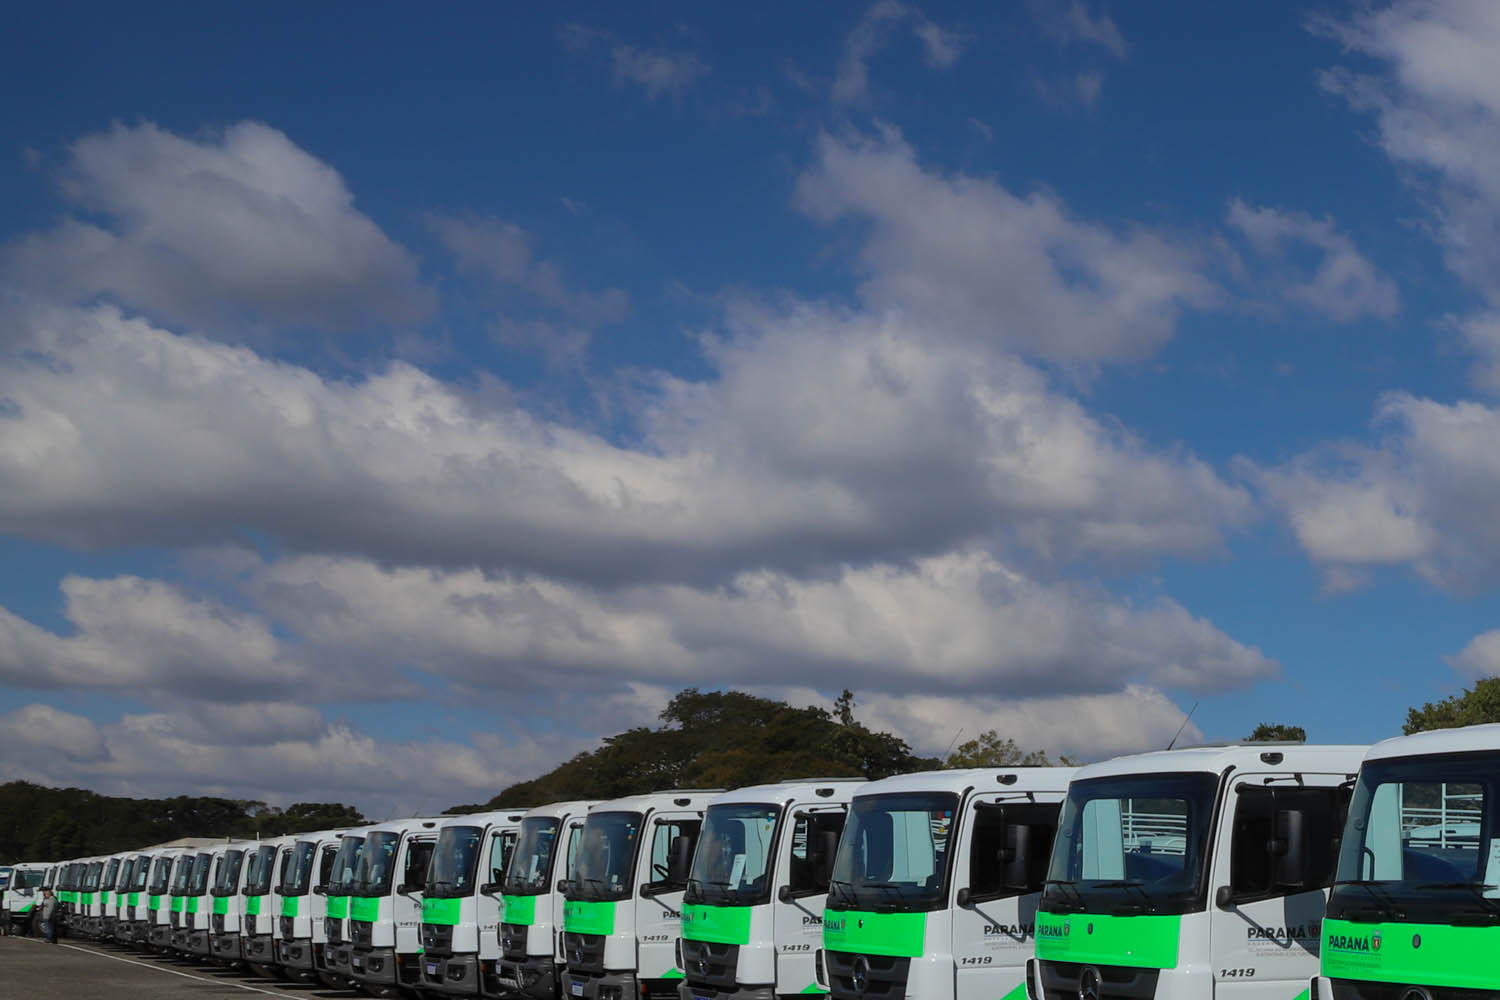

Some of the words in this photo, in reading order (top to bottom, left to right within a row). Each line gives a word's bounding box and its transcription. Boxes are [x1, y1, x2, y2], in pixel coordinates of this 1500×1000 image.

[1247, 925, 1306, 939] PARANÁ
[782, 944, 810, 952] 1419
[1328, 935, 1370, 952] PARANÁ
[961, 956, 993, 965] 1419
[1220, 968, 1256, 978] 1419
